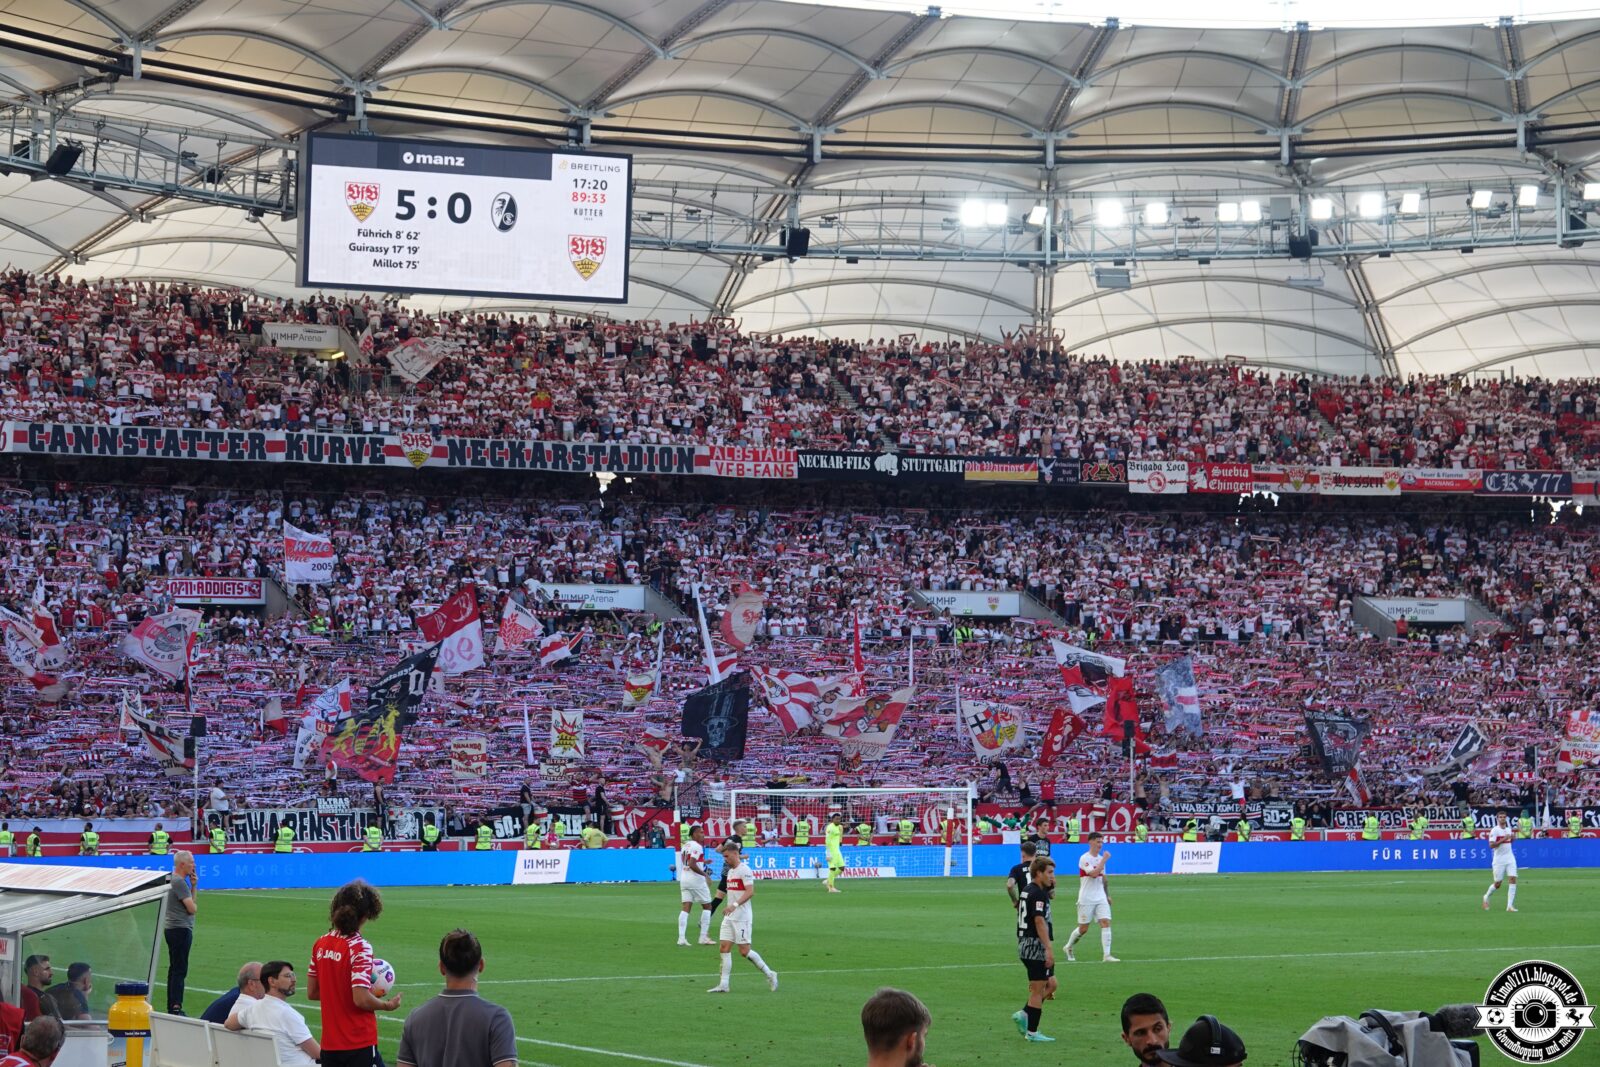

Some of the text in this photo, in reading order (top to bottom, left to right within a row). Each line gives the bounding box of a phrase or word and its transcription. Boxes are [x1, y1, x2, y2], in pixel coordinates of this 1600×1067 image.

[416, 154, 465, 167] manz
[570, 163, 621, 173] BREITLING
[573, 179, 608, 190] 17:20
[571, 192, 606, 204] 89:33
[357, 229, 393, 239] Führich
[348, 243, 390, 256] Guirassy
[372, 258, 403, 269] Millot
[280, 333, 298, 341] MHP
[28, 423, 267, 460] CANNSTATTER
[285, 432, 386, 465] KURVE
[447, 438, 695, 474] NECKARSTADION
[712, 446, 797, 463] ALBSTADT
[715, 461, 795, 477] VFB-FANS
[798, 454, 965, 473] NECKAR-FILS STUTTGART
[965, 461, 1025, 473] Old Warriors
[1128, 461, 1186, 472] Brigada Loca
[1211, 466, 1249, 478] Suebia
[311, 562, 333, 572] 2005
[197, 581, 244, 595] ADDICTS
[590, 594, 614, 603] Arena
[937, 597, 957, 605] MHP
[1395, 607, 1413, 615] MHP
[317, 798, 350, 806] ULTRAS
[1262, 808, 1293, 823] 50+1
[921, 836, 933, 845] 35
[1191, 850, 1214, 860] MHP
[1372, 847, 1402, 860] FÜR
[1412, 848, 1439, 860] EIN
[535, 858, 561, 869] MHP
[789, 857, 818, 868] EIN
[752, 870, 800, 879] WINAMAX
